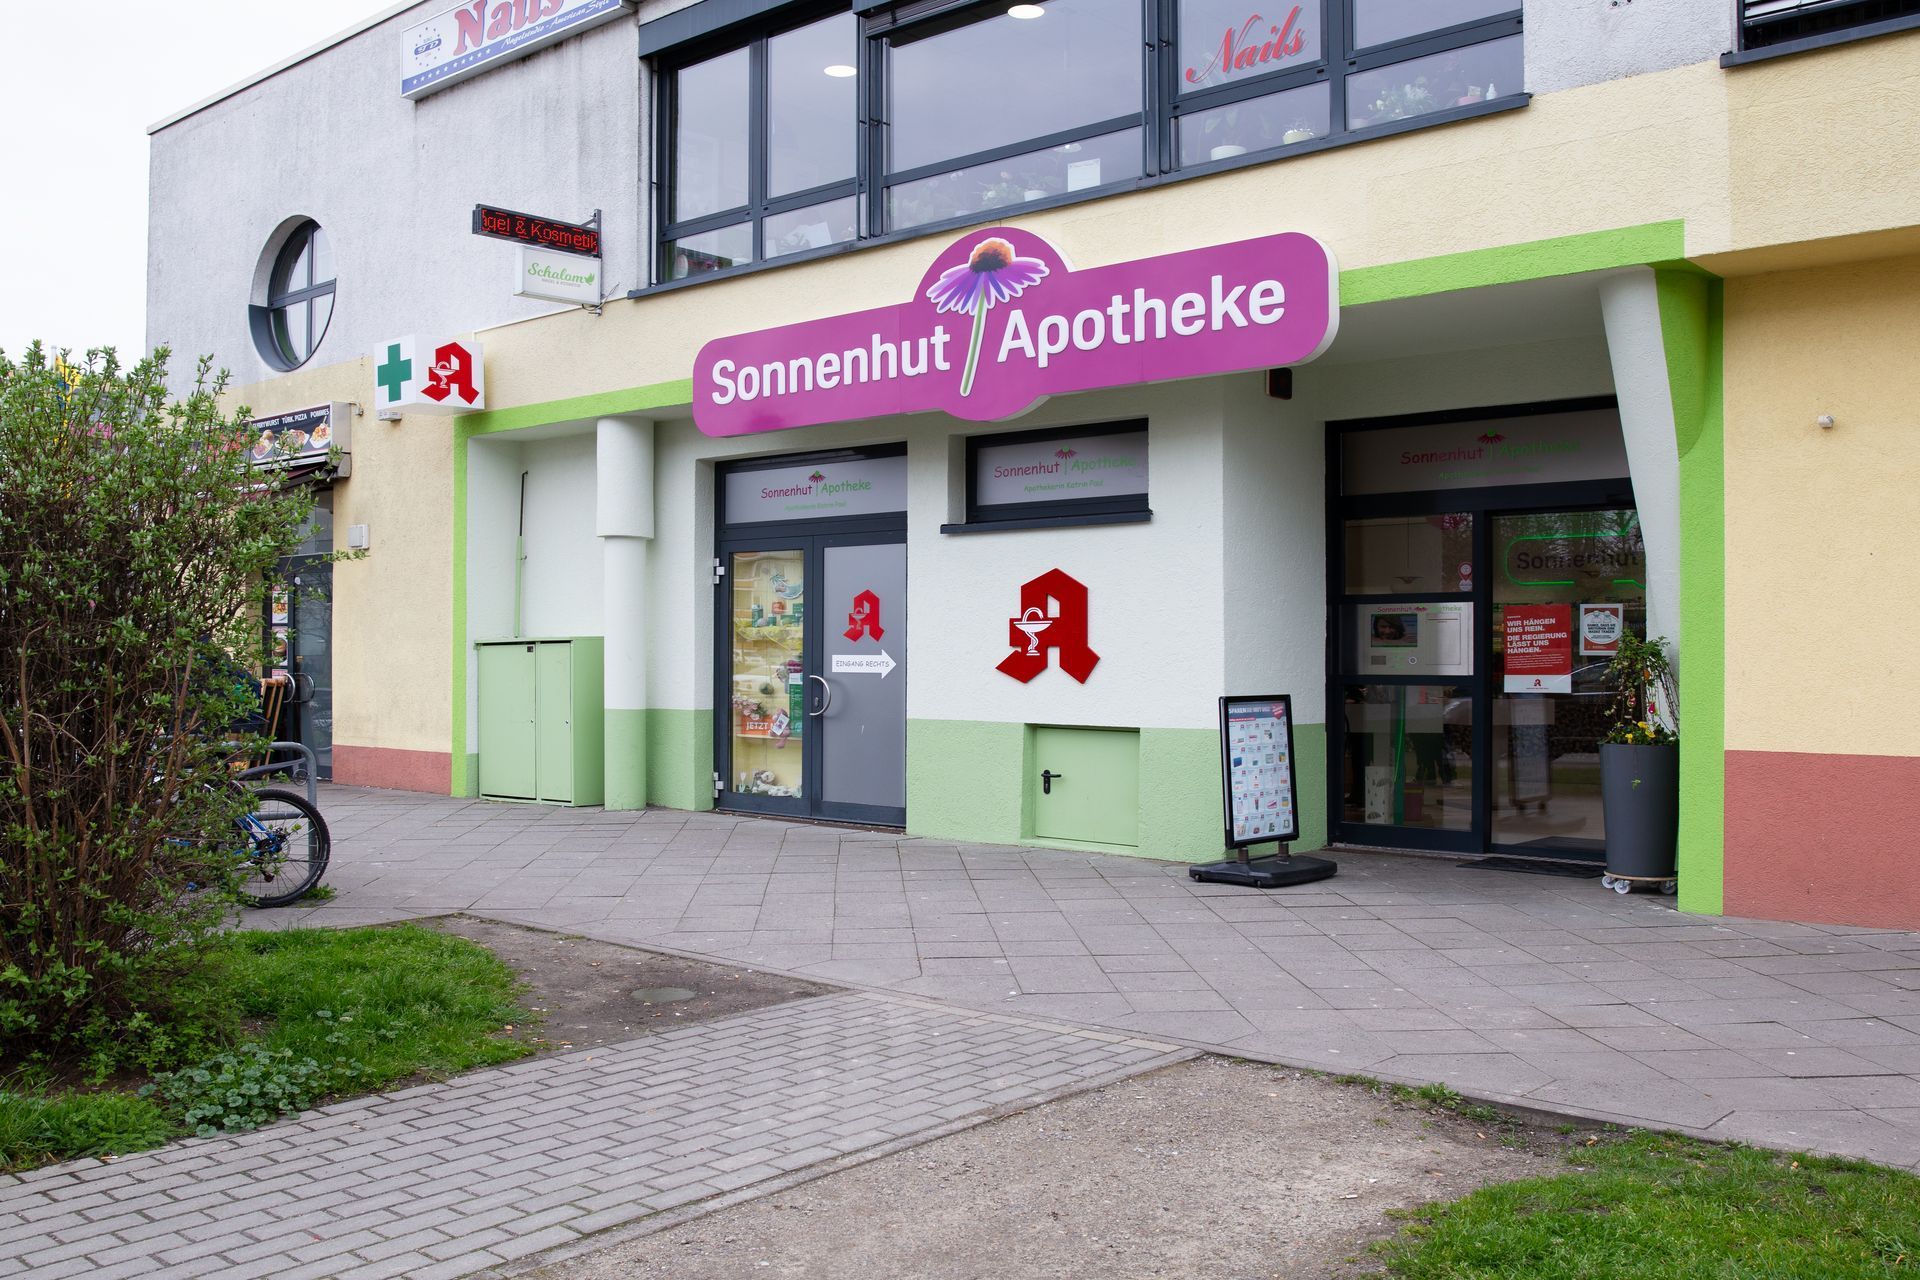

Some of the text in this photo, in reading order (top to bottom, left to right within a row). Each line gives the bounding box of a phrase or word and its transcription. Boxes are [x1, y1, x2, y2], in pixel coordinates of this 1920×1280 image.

[549, 9, 587, 30] American
[1186, 5, 1304, 82] Nails
[515, 221, 527, 234] &
[531, 223, 597, 249] Kosmetik
[711, 274, 1287, 405] Sonnenhut Apotheke
[310, 408, 329, 419] POMMES
[1400, 447, 1485, 464] Sonnenhut
[994, 456, 1137, 478] Sonnenhut Apotheke
[761, 479, 871, 499] Sonnenhut Apotheke
[1523, 617, 1556, 626] HÄNGEN
[1507, 624, 1545, 634] UNS REIN.
[1522, 632, 1568, 641] REGIERUNG
[1507, 639, 1549, 648] LÄSST UNS
[1507, 646, 1542, 654] HÄNGEN.
[835, 660, 890, 668] EINGANG RECHTS
[746, 721, 769, 731] JETZT
